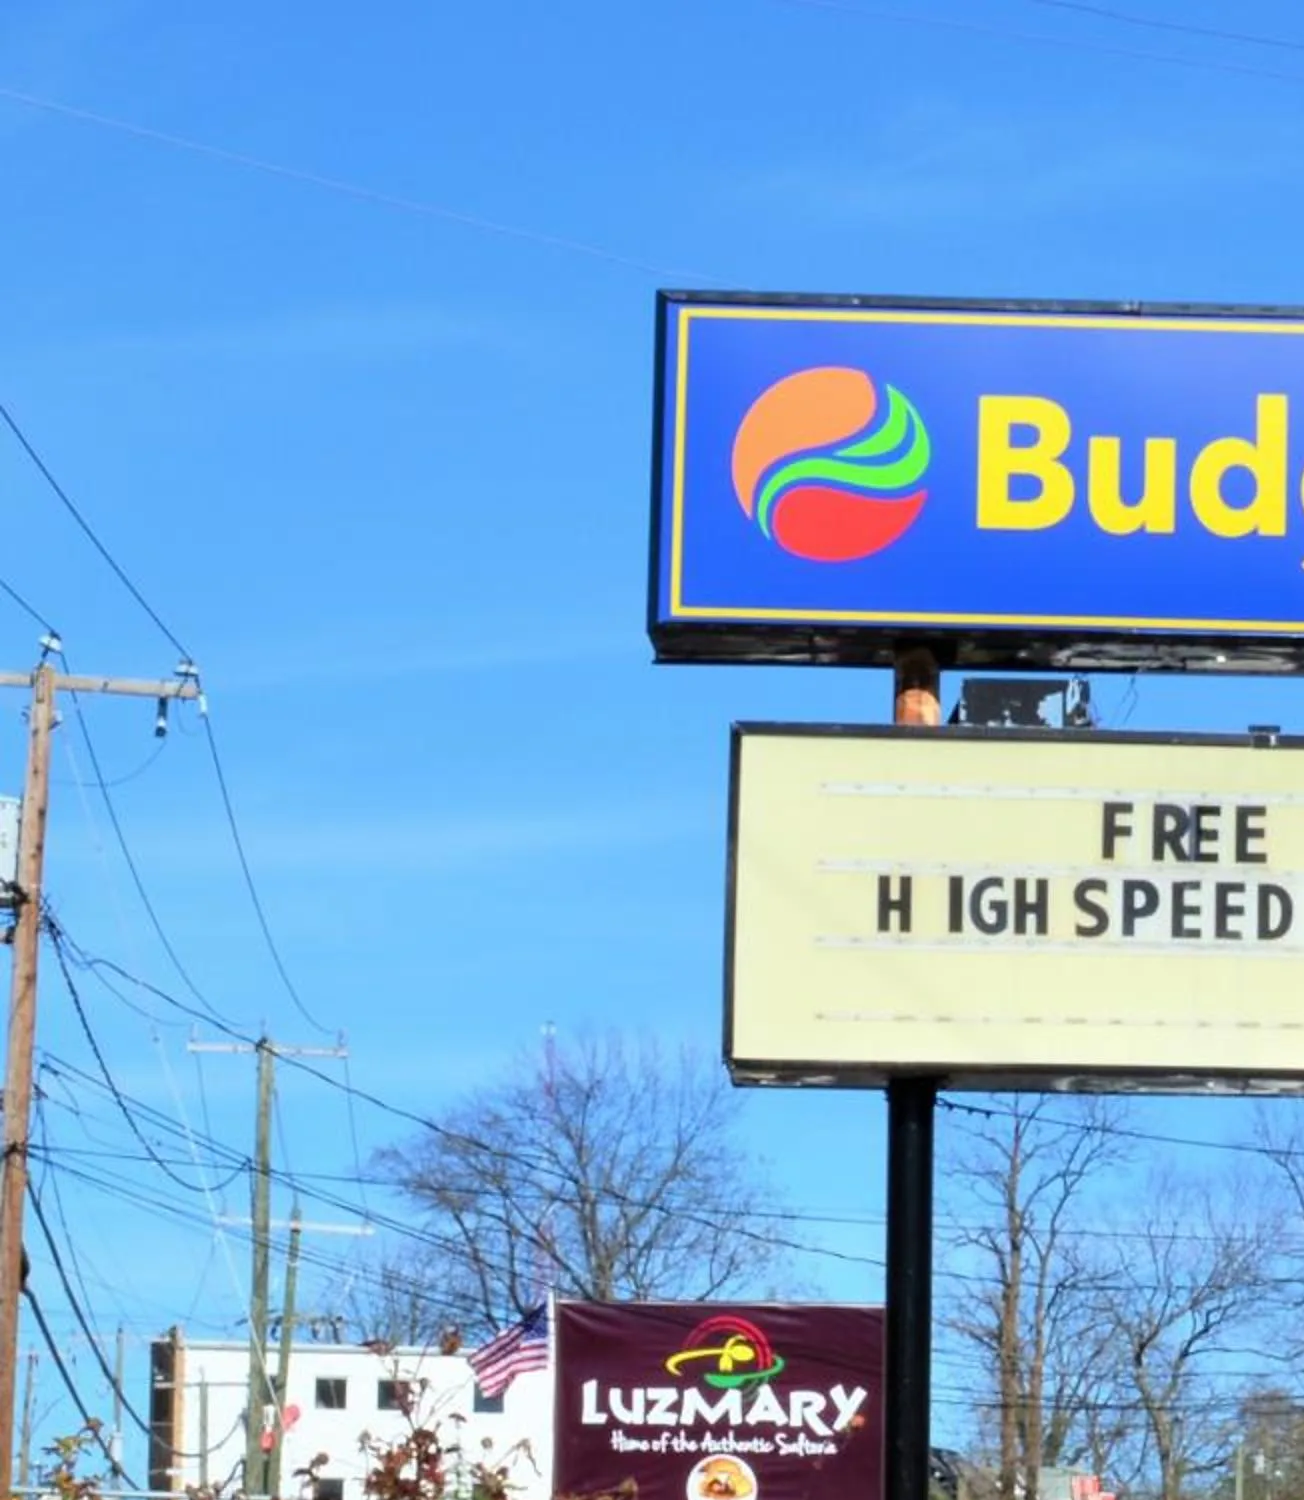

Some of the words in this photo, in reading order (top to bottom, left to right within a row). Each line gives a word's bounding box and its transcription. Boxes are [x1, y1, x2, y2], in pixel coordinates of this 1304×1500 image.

[1102, 803, 1267, 863] FREE
[1074, 878, 1293, 940] SPEED
[581, 1379, 868, 1436] LUZMARY
[651, 1431, 671, 1454] of
[671, 1429, 699, 1452] the
